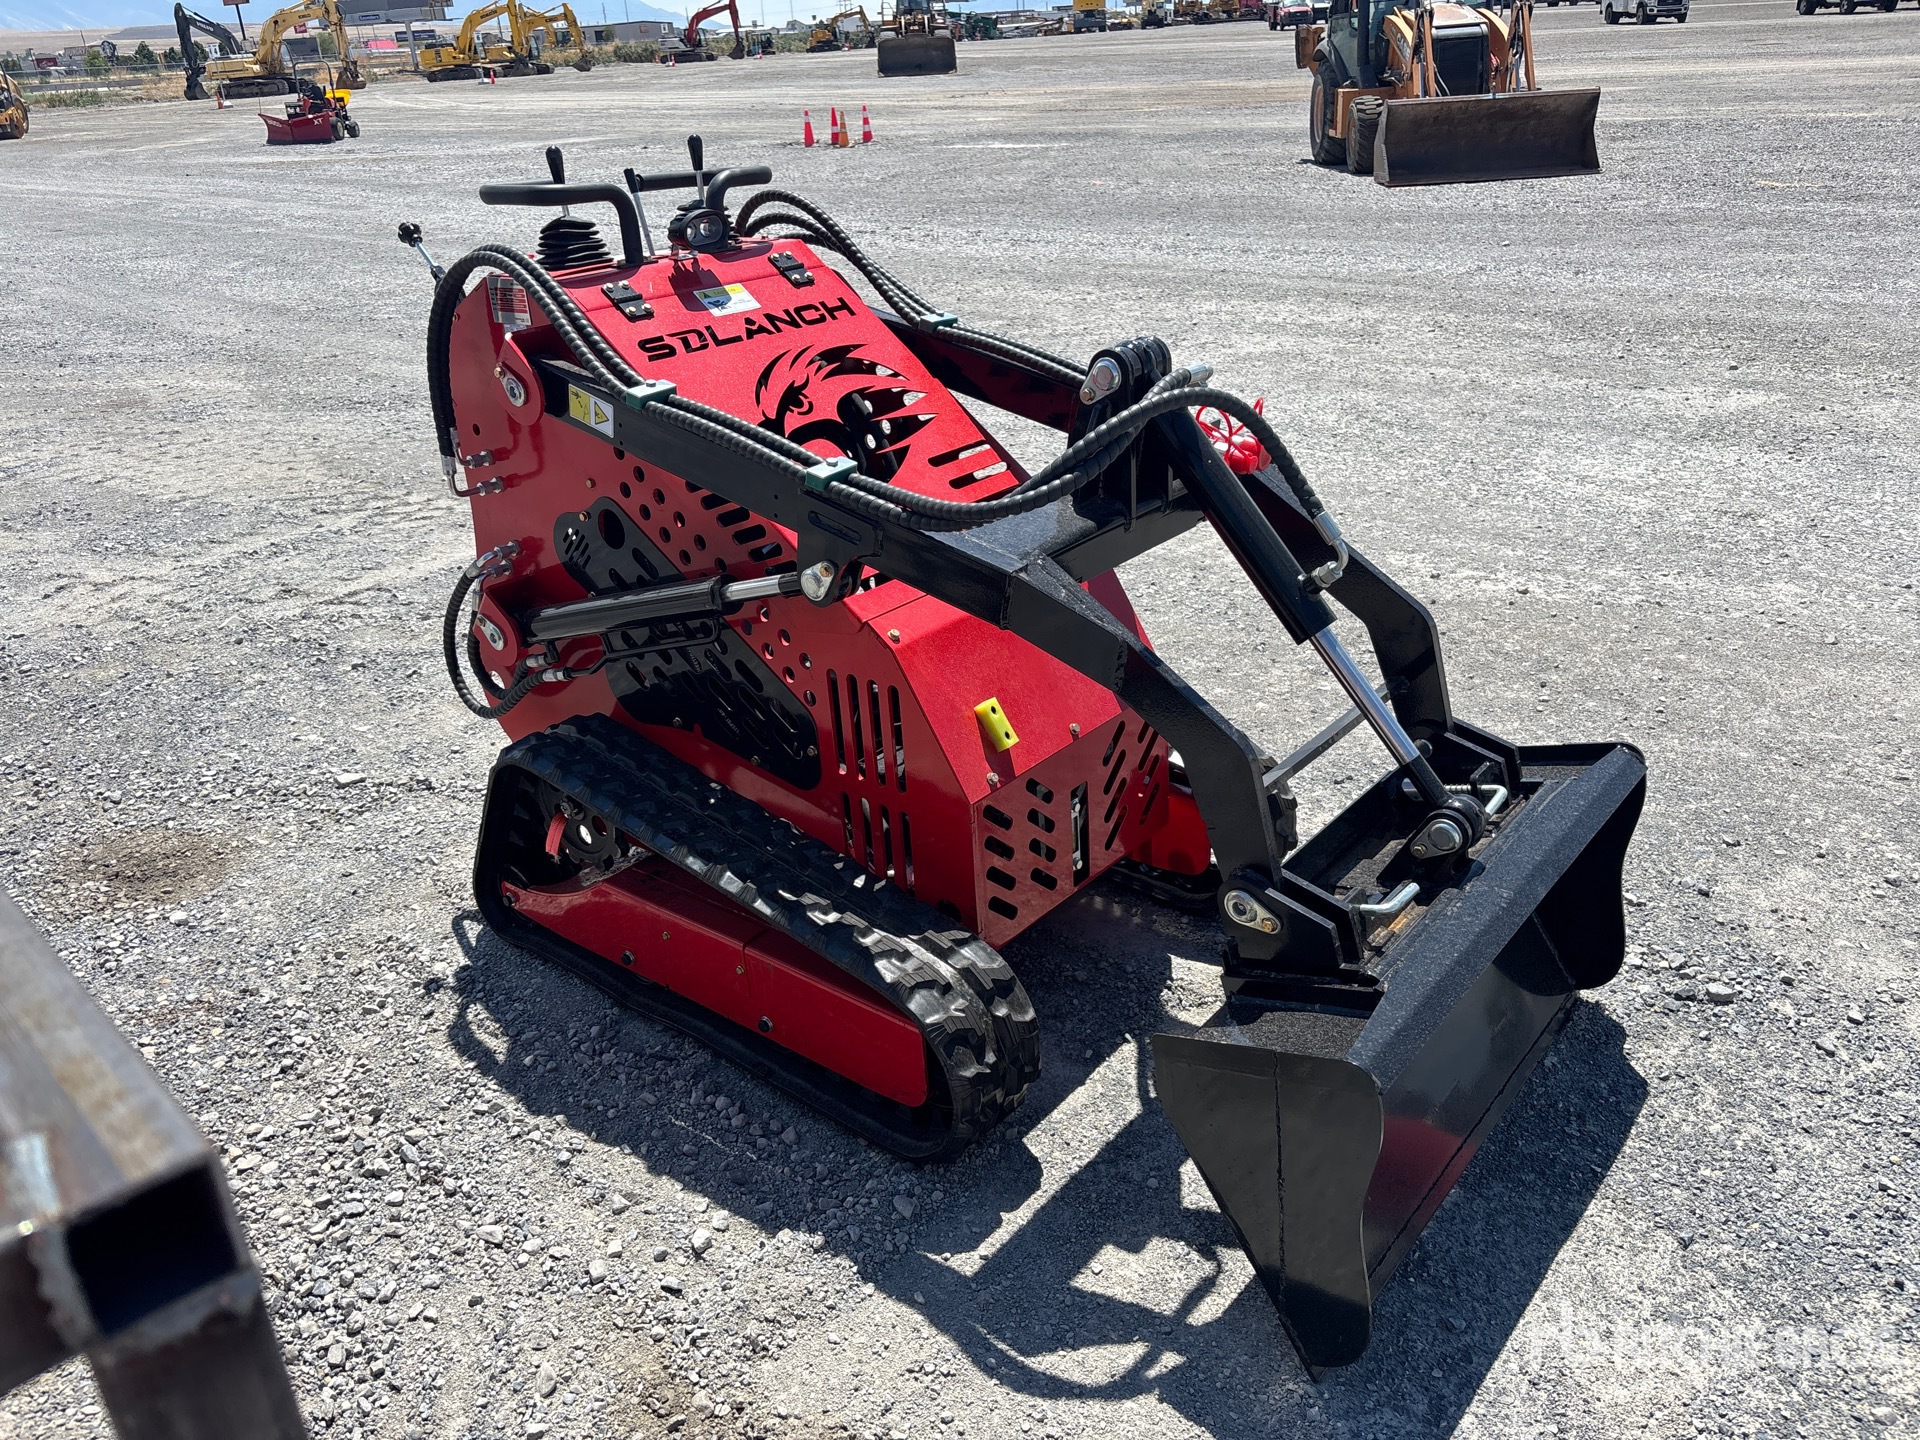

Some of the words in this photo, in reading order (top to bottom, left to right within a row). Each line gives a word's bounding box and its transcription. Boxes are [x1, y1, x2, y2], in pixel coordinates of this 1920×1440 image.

[196, 21, 214, 32] VOLVO
[313, 117, 324, 126] XT
[637, 297, 857, 362] SDLANCH
